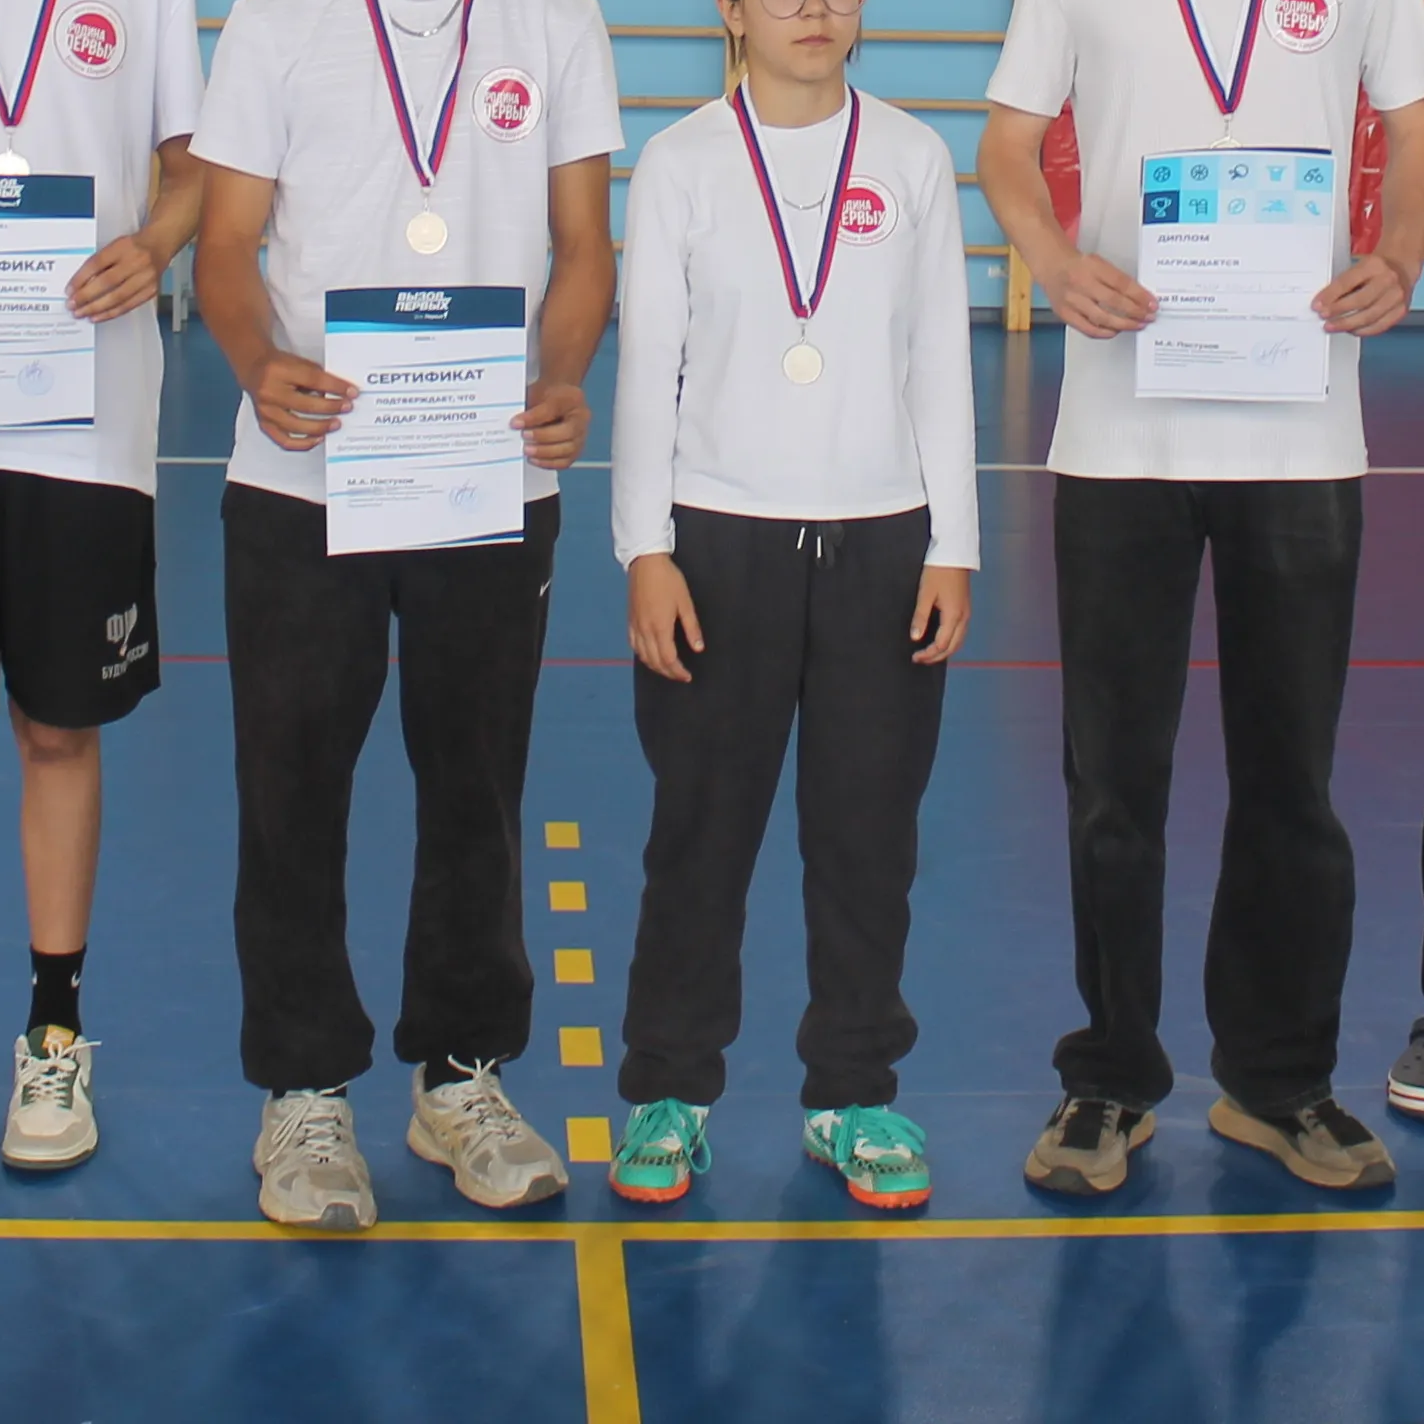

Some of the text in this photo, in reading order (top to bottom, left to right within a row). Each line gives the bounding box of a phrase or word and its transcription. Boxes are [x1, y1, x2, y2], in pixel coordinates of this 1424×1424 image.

[844, 199, 872, 213] ДИНА
[841, 210, 887, 226] ЕРВЫХ
[1157, 234, 1210, 243] ДИПЛОМ
[1157, 259, 1239, 267] НАГРАЖДАЕТСЯ
[29, 285, 47, 293] ЧТО
[367, 368, 485, 385] СЕРТИФИКАТ
[457, 393, 475, 402] ЧТО
[374, 412, 477, 424] АЙДАР ЗАРИПОВ
